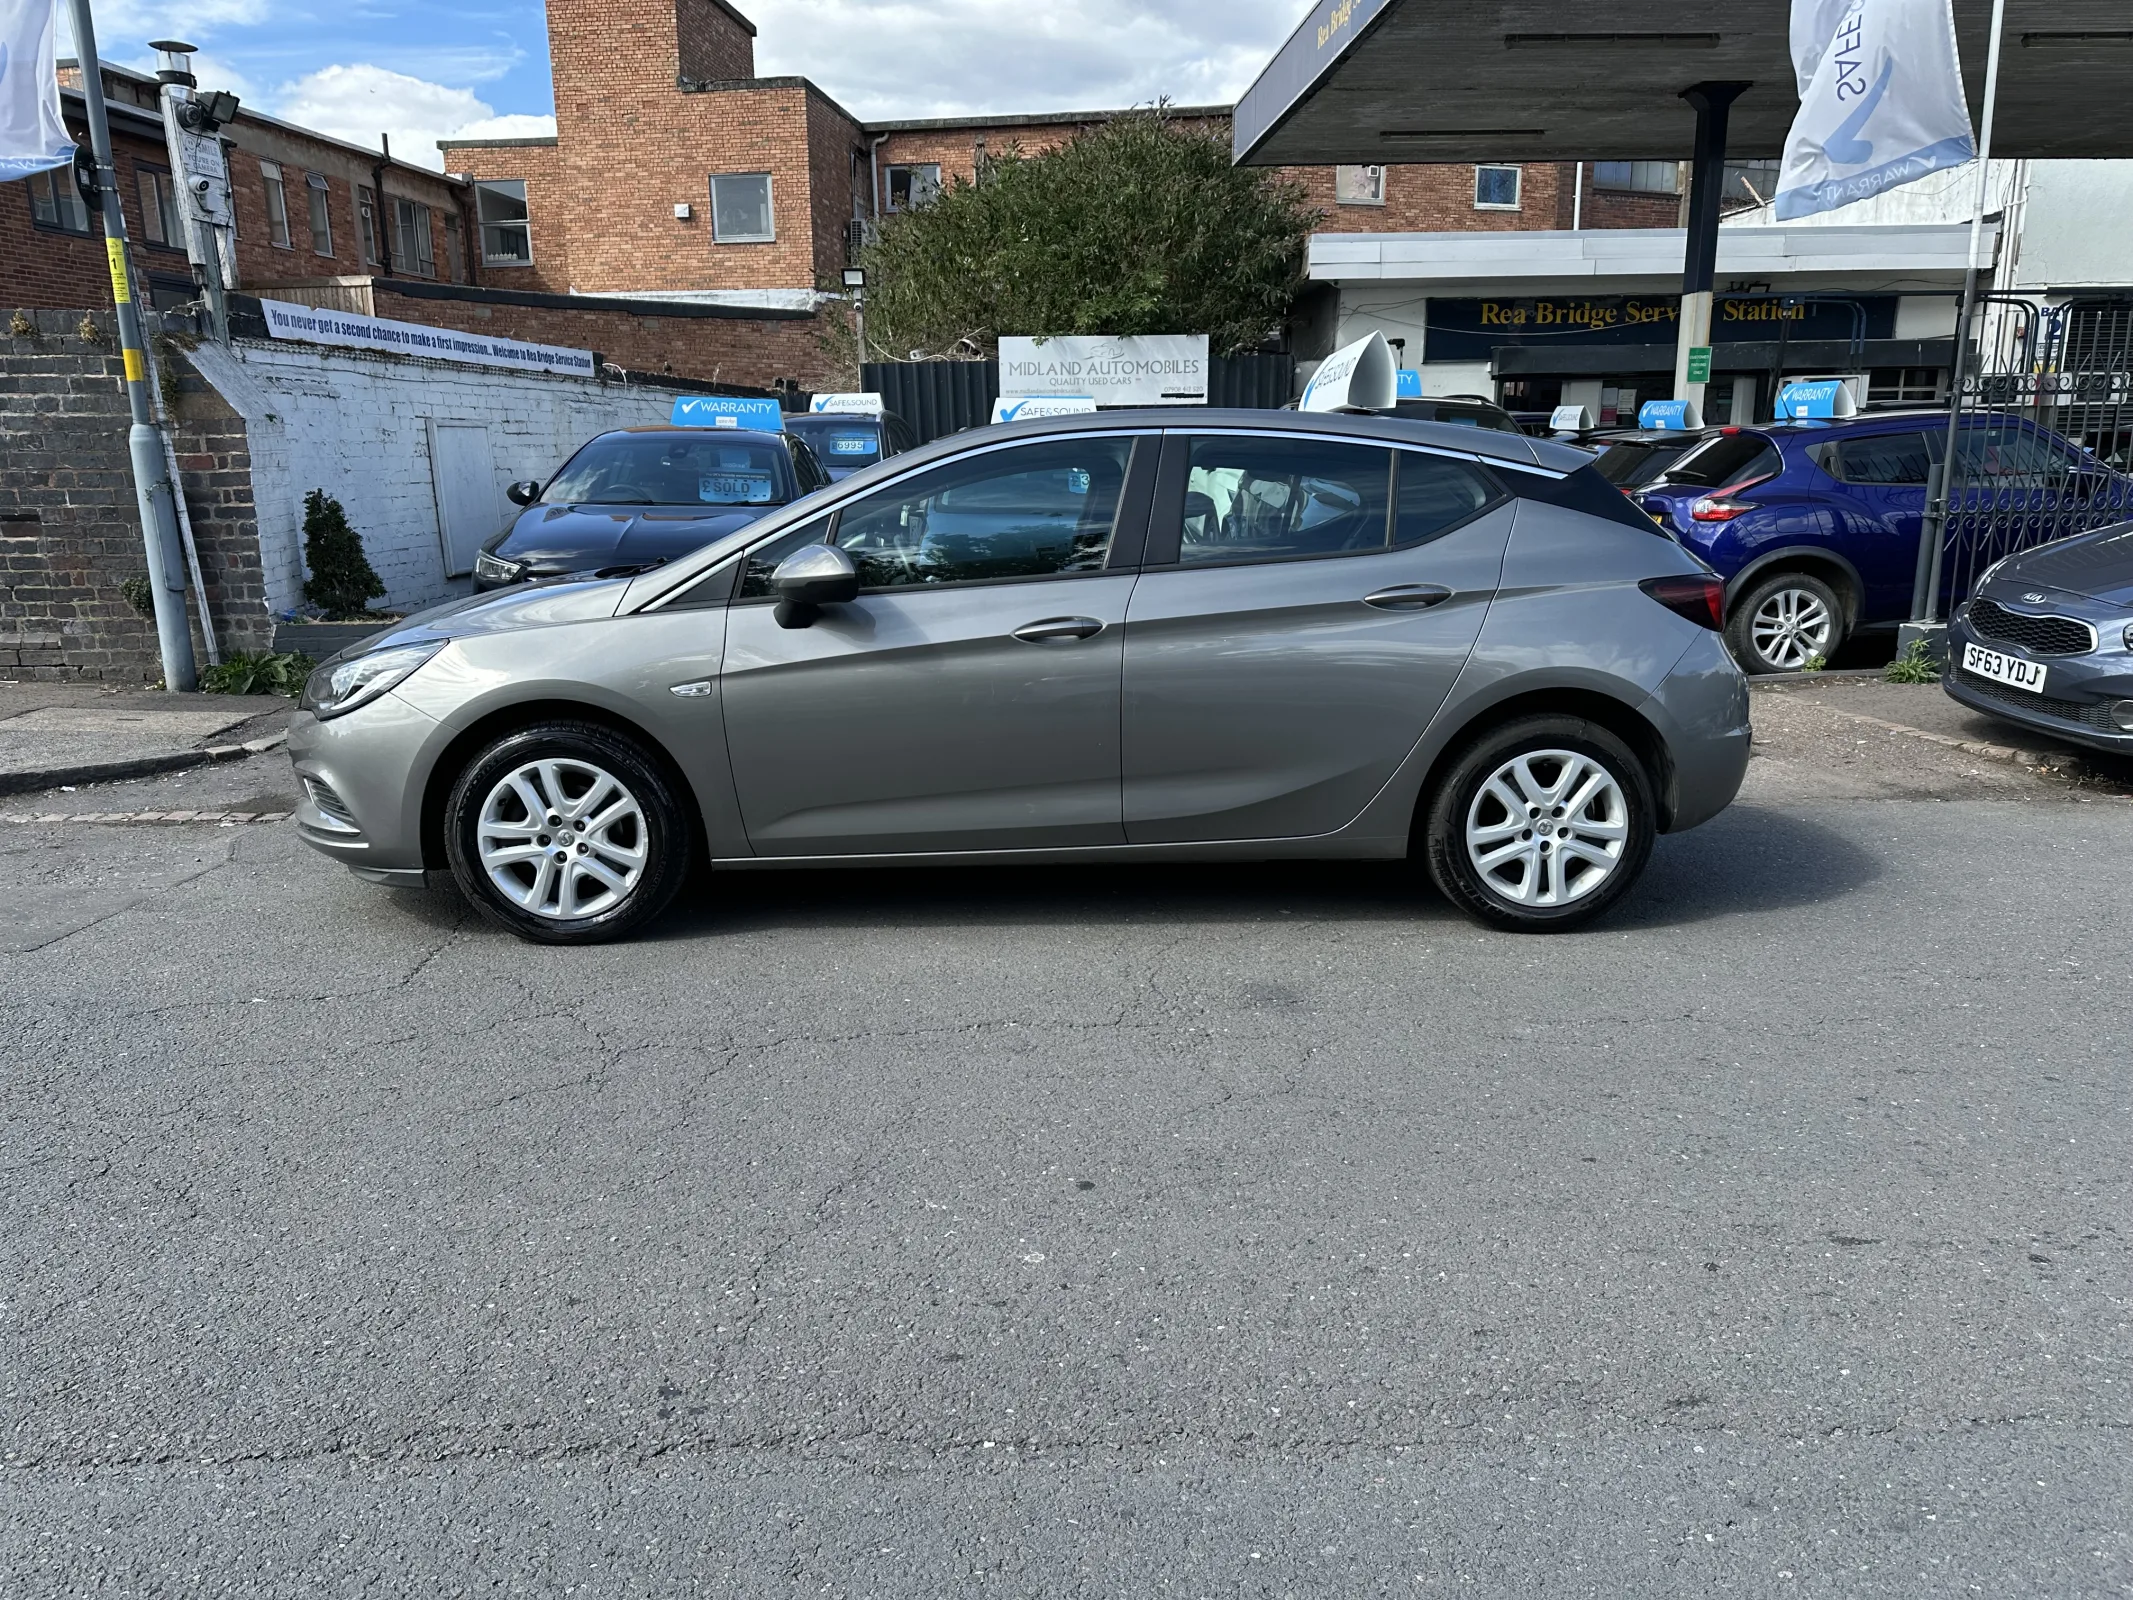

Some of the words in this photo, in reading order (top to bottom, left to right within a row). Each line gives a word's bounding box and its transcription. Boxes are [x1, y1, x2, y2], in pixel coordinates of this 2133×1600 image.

[1480, 303, 1527, 325] Rea
[1535, 302, 1618, 329] Bridge
[1625, 301, 1681, 323] Serv
[271, 309, 290, 327] You
[291, 314, 317, 331] never
[318, 319, 334, 334] get
[334, 322, 340, 334] a
[341, 322, 371, 339] second
[372, 327, 401, 342] chance
[401, 330, 410, 344] to
[411, 332, 431, 348] make
[431, 338, 437, 349] a
[437, 335, 452, 350] first
[492, 343, 520, 360] Welcome
[520, 348, 527, 361] to
[537, 350, 555, 365] Bridge
[555, 352, 574, 367] Service
[573, 355, 591, 369] Station
[1008, 361, 1082, 376] MIDLAND
[1087, 359, 1199, 376] AUTOMOBILES
[1049, 377, 1086, 387] QUALITY
[1088, 376, 1108, 385] USED
[1110, 376, 1132, 385] CARS
[1791, 387, 1834, 401] WARRANTY
[700, 402, 773, 414] WARRANTY
[1650, 404, 1684, 416] WARRANTY
[713, 481, 750, 494] SOLD
[2023, 592, 2043, 602] KIA
[1969, 647, 2002, 675] SF63
[2006, 658, 2039, 686] YDJ
